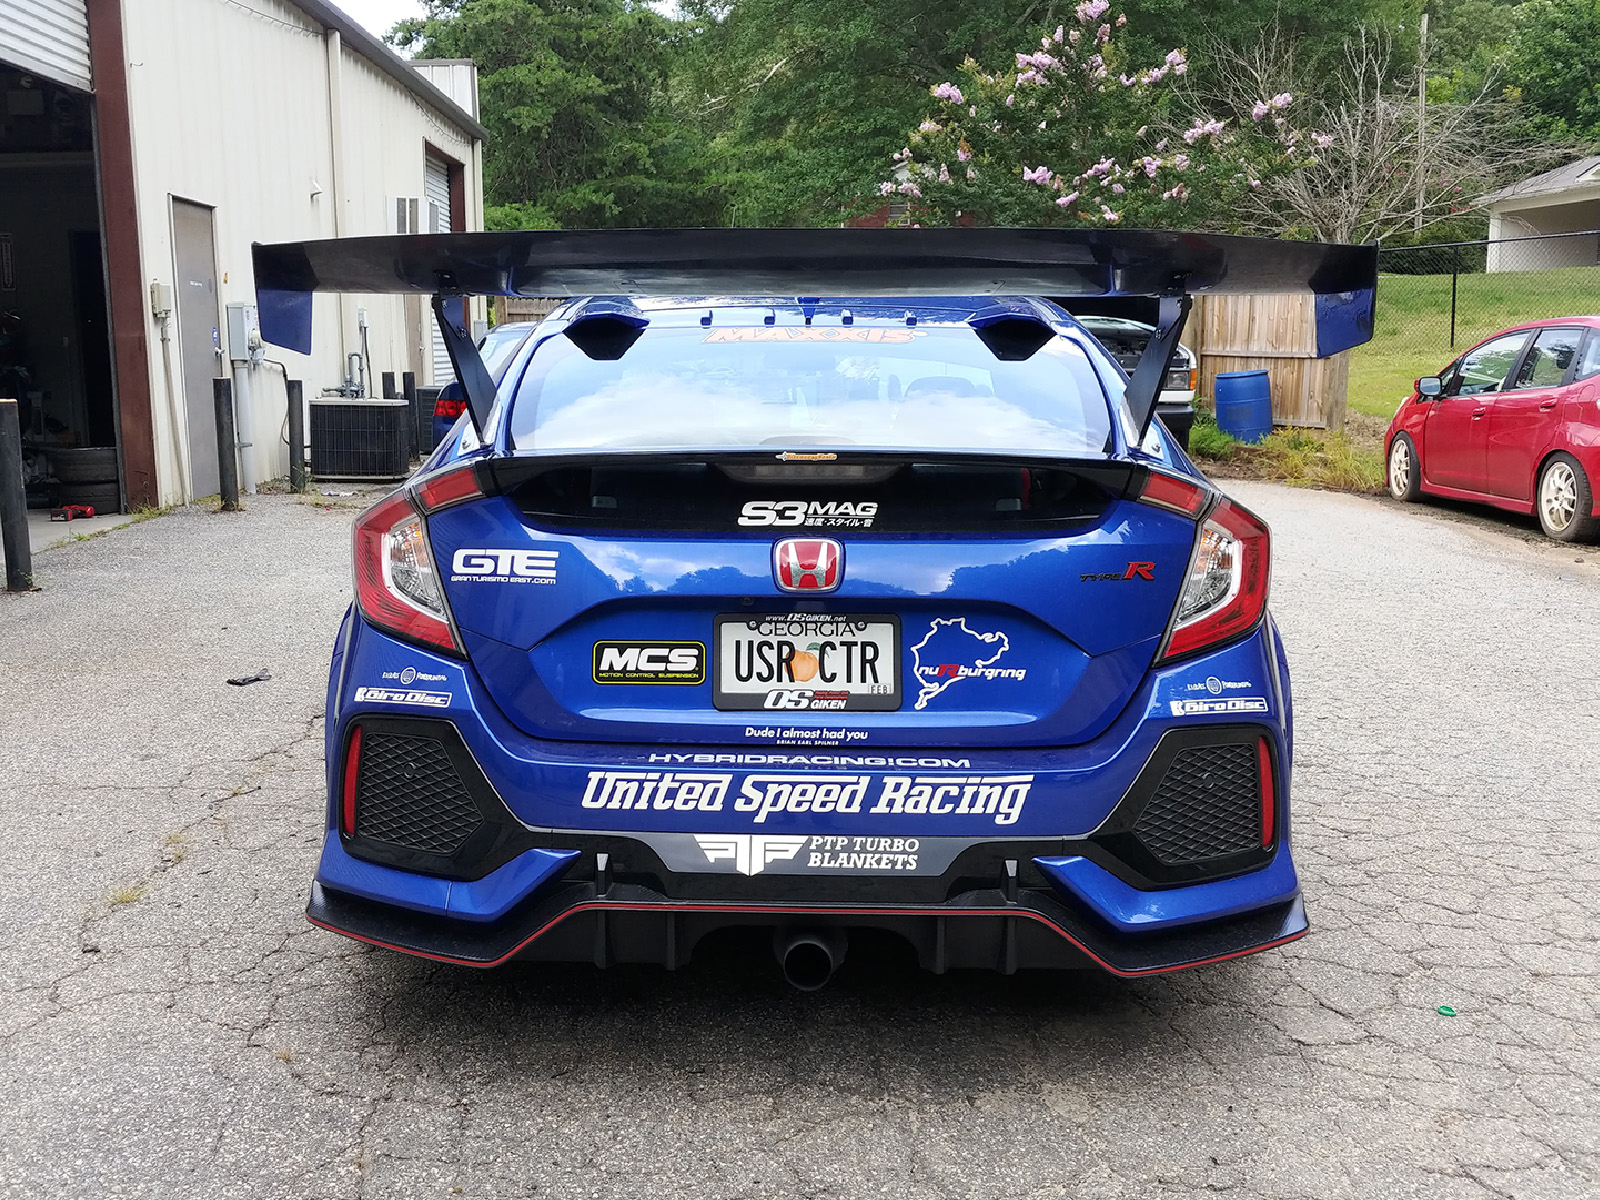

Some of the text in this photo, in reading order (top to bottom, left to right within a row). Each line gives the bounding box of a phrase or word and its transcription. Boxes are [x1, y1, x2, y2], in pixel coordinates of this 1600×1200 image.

[700, 327, 916, 343] MAXXIS
[737, 501, 879, 527] S3 MAG
[452, 548, 560, 578] GTE
[1080, 561, 1157, 582] TYPE R
[757, 621, 856, 637] GEORGIA
[599, 647, 699, 672] MCS
[734, 640, 880, 684] USR CTR
[763, 689, 814, 710] OS
[811, 699, 848, 710] GIKEN
[870, 684, 888, 695] FEB
[744, 727, 776, 738] Dude
[782, 727, 821, 739] almost
[822, 728, 846, 740] had
[845, 730, 869, 742] you
[581, 771, 1035, 825] United Speed Racing
[809, 835, 920, 852] PTP TURBO
[807, 852, 919, 871] BLANKETS
